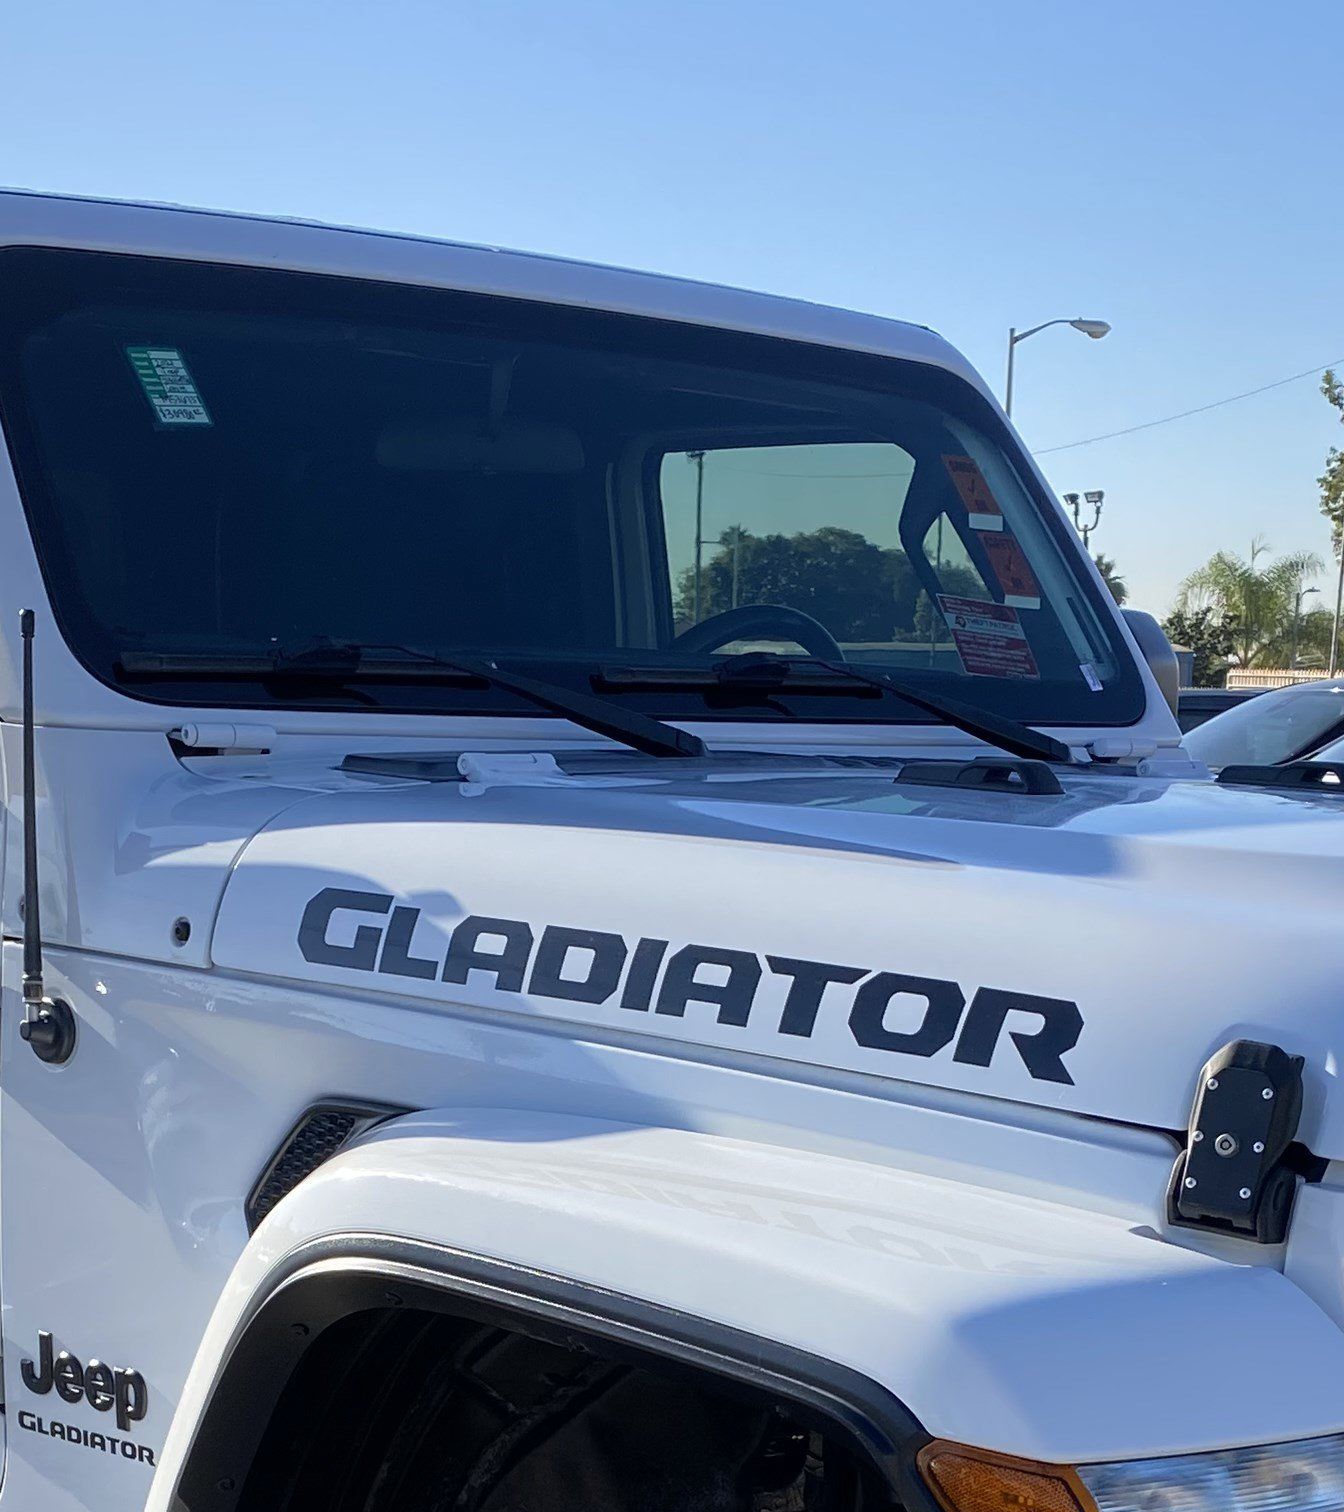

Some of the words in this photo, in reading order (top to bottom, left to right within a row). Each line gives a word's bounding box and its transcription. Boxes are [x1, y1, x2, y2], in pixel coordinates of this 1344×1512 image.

[297, 886, 1085, 1087] GLADIATOR
[20, 1329, 149, 1432] Jeep
[18, 1410, 156, 1467] GLADIATOR
